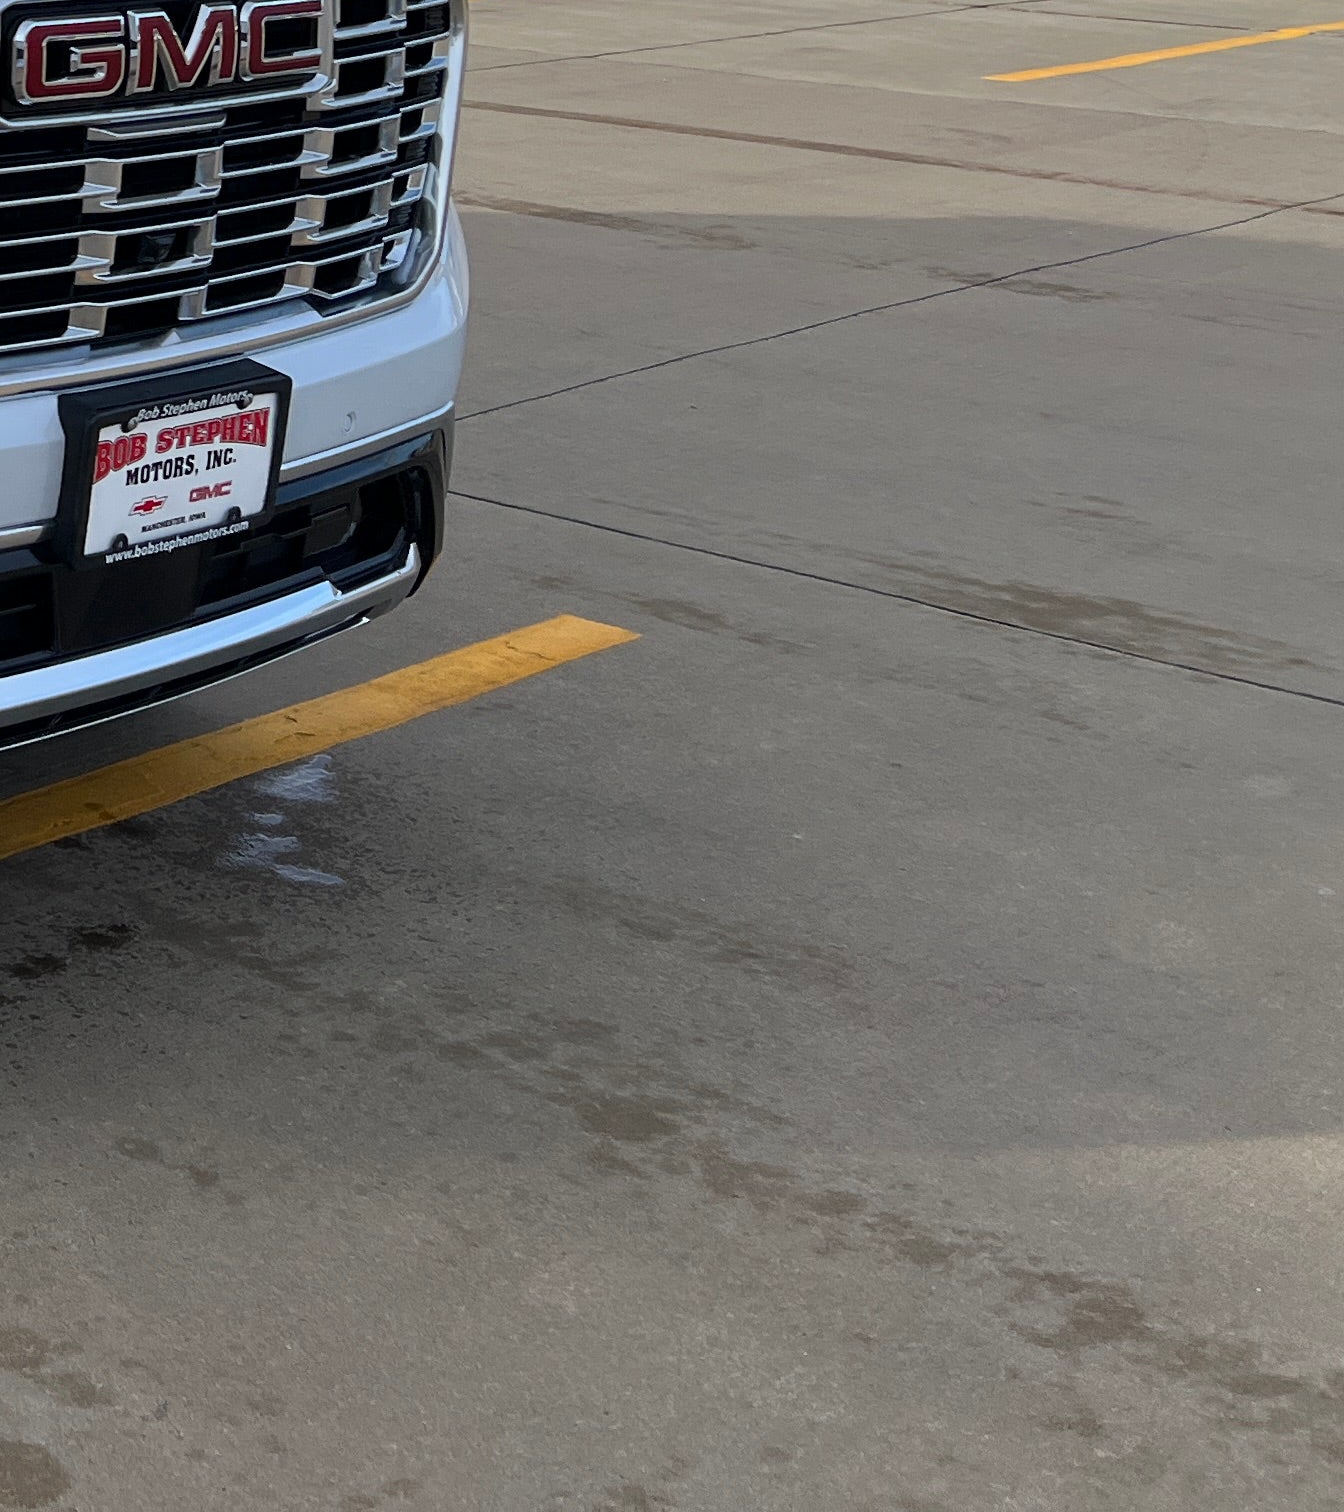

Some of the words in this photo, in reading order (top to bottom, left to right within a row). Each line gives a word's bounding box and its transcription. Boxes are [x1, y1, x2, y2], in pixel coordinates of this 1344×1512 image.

[136, 406, 160, 421] Bob
[161, 399, 207, 416] Stephen
[209, 390, 249, 406] Motors
[92, 433, 148, 484] BOB
[155, 407, 270, 453] STEPHEN
[126, 454, 199, 486] MOTORS,
[206, 448, 237, 470] INC.
[189, 480, 232, 502] GMC
[105, 521, 249, 564] www.bobstephenmotors.com
